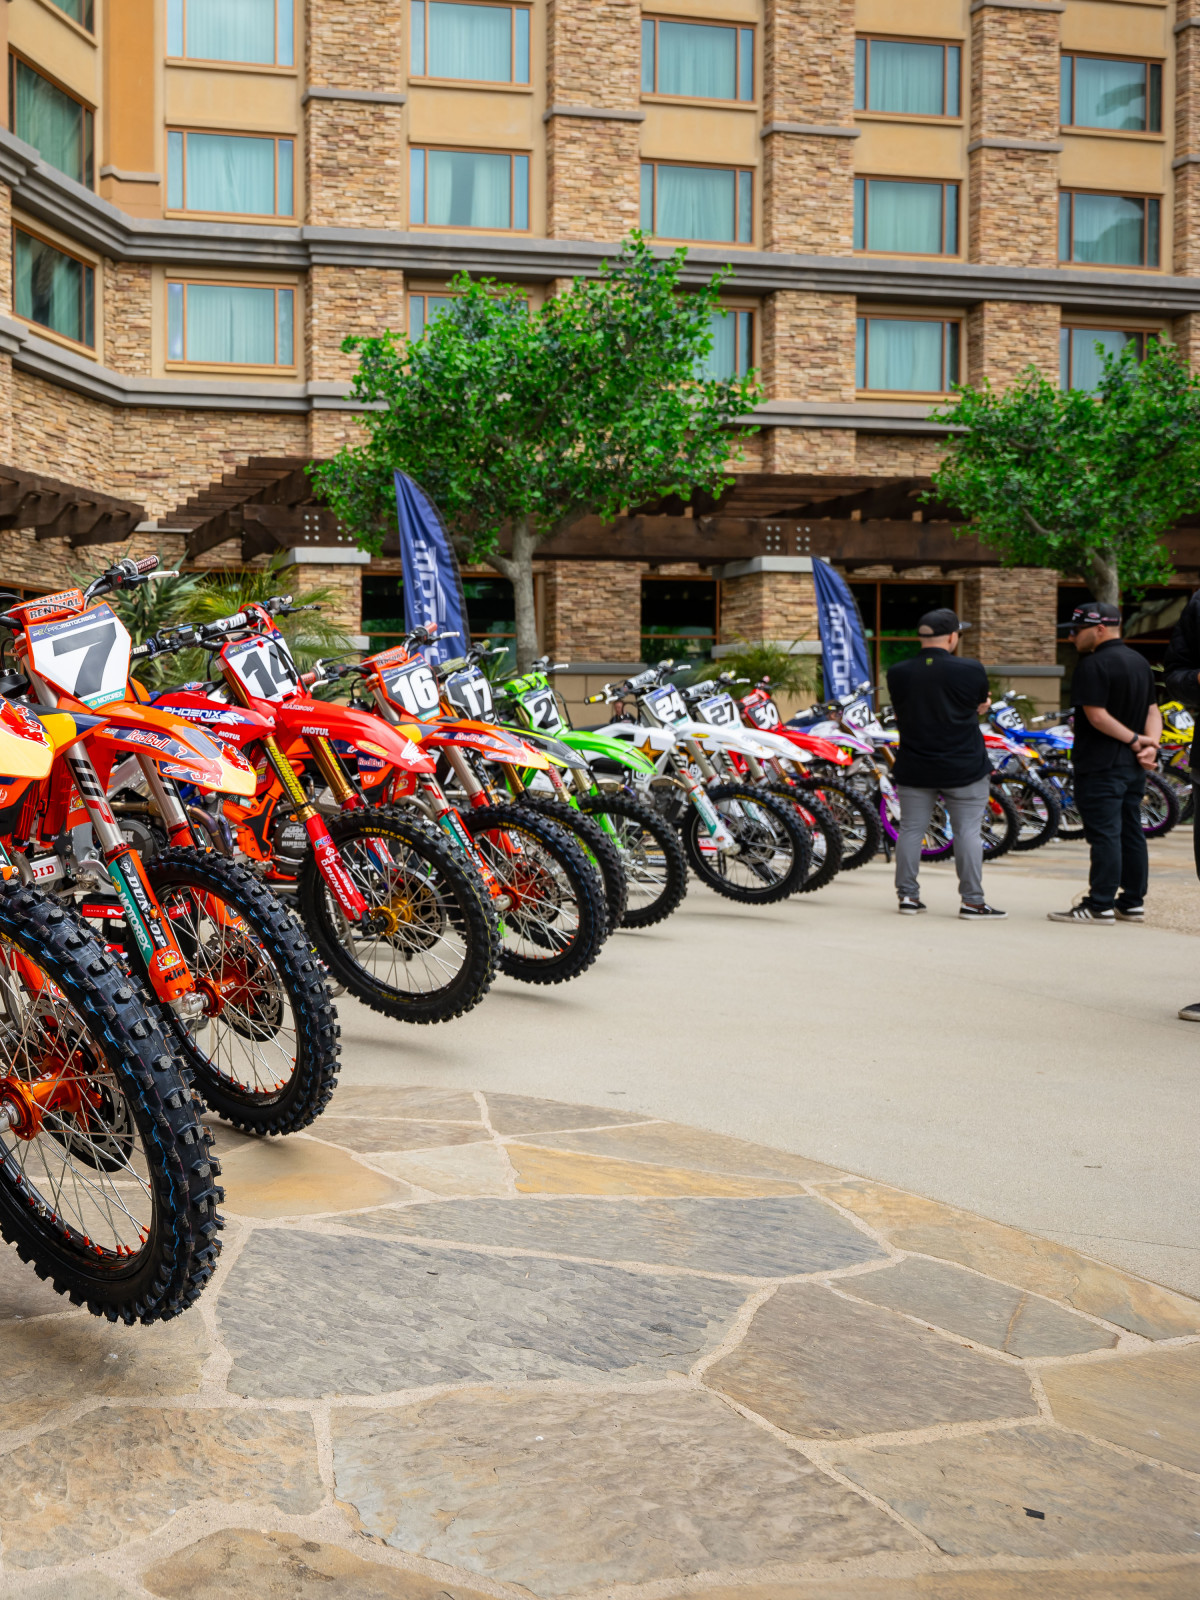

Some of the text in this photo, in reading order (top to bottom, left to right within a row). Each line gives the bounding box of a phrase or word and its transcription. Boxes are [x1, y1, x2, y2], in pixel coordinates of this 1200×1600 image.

[52, 622, 117, 699] 7
[391, 667, 440, 717] 16
[461, 678, 493, 717] 17
[163, 706, 222, 719] PHOENIX
[534, 698, 559, 729] 2
[656, 693, 686, 722] 24
[710, 701, 735, 726] 27
[755, 702, 780, 729] 30
[126, 730, 148, 744] Red
[145, 733, 171, 750] Bull
[218, 731, 241, 741] MOTUL
[302, 726, 330, 736] MOTUL
[119, 893, 151, 951] MOTOREX
[164, 967, 187, 983] KTM
